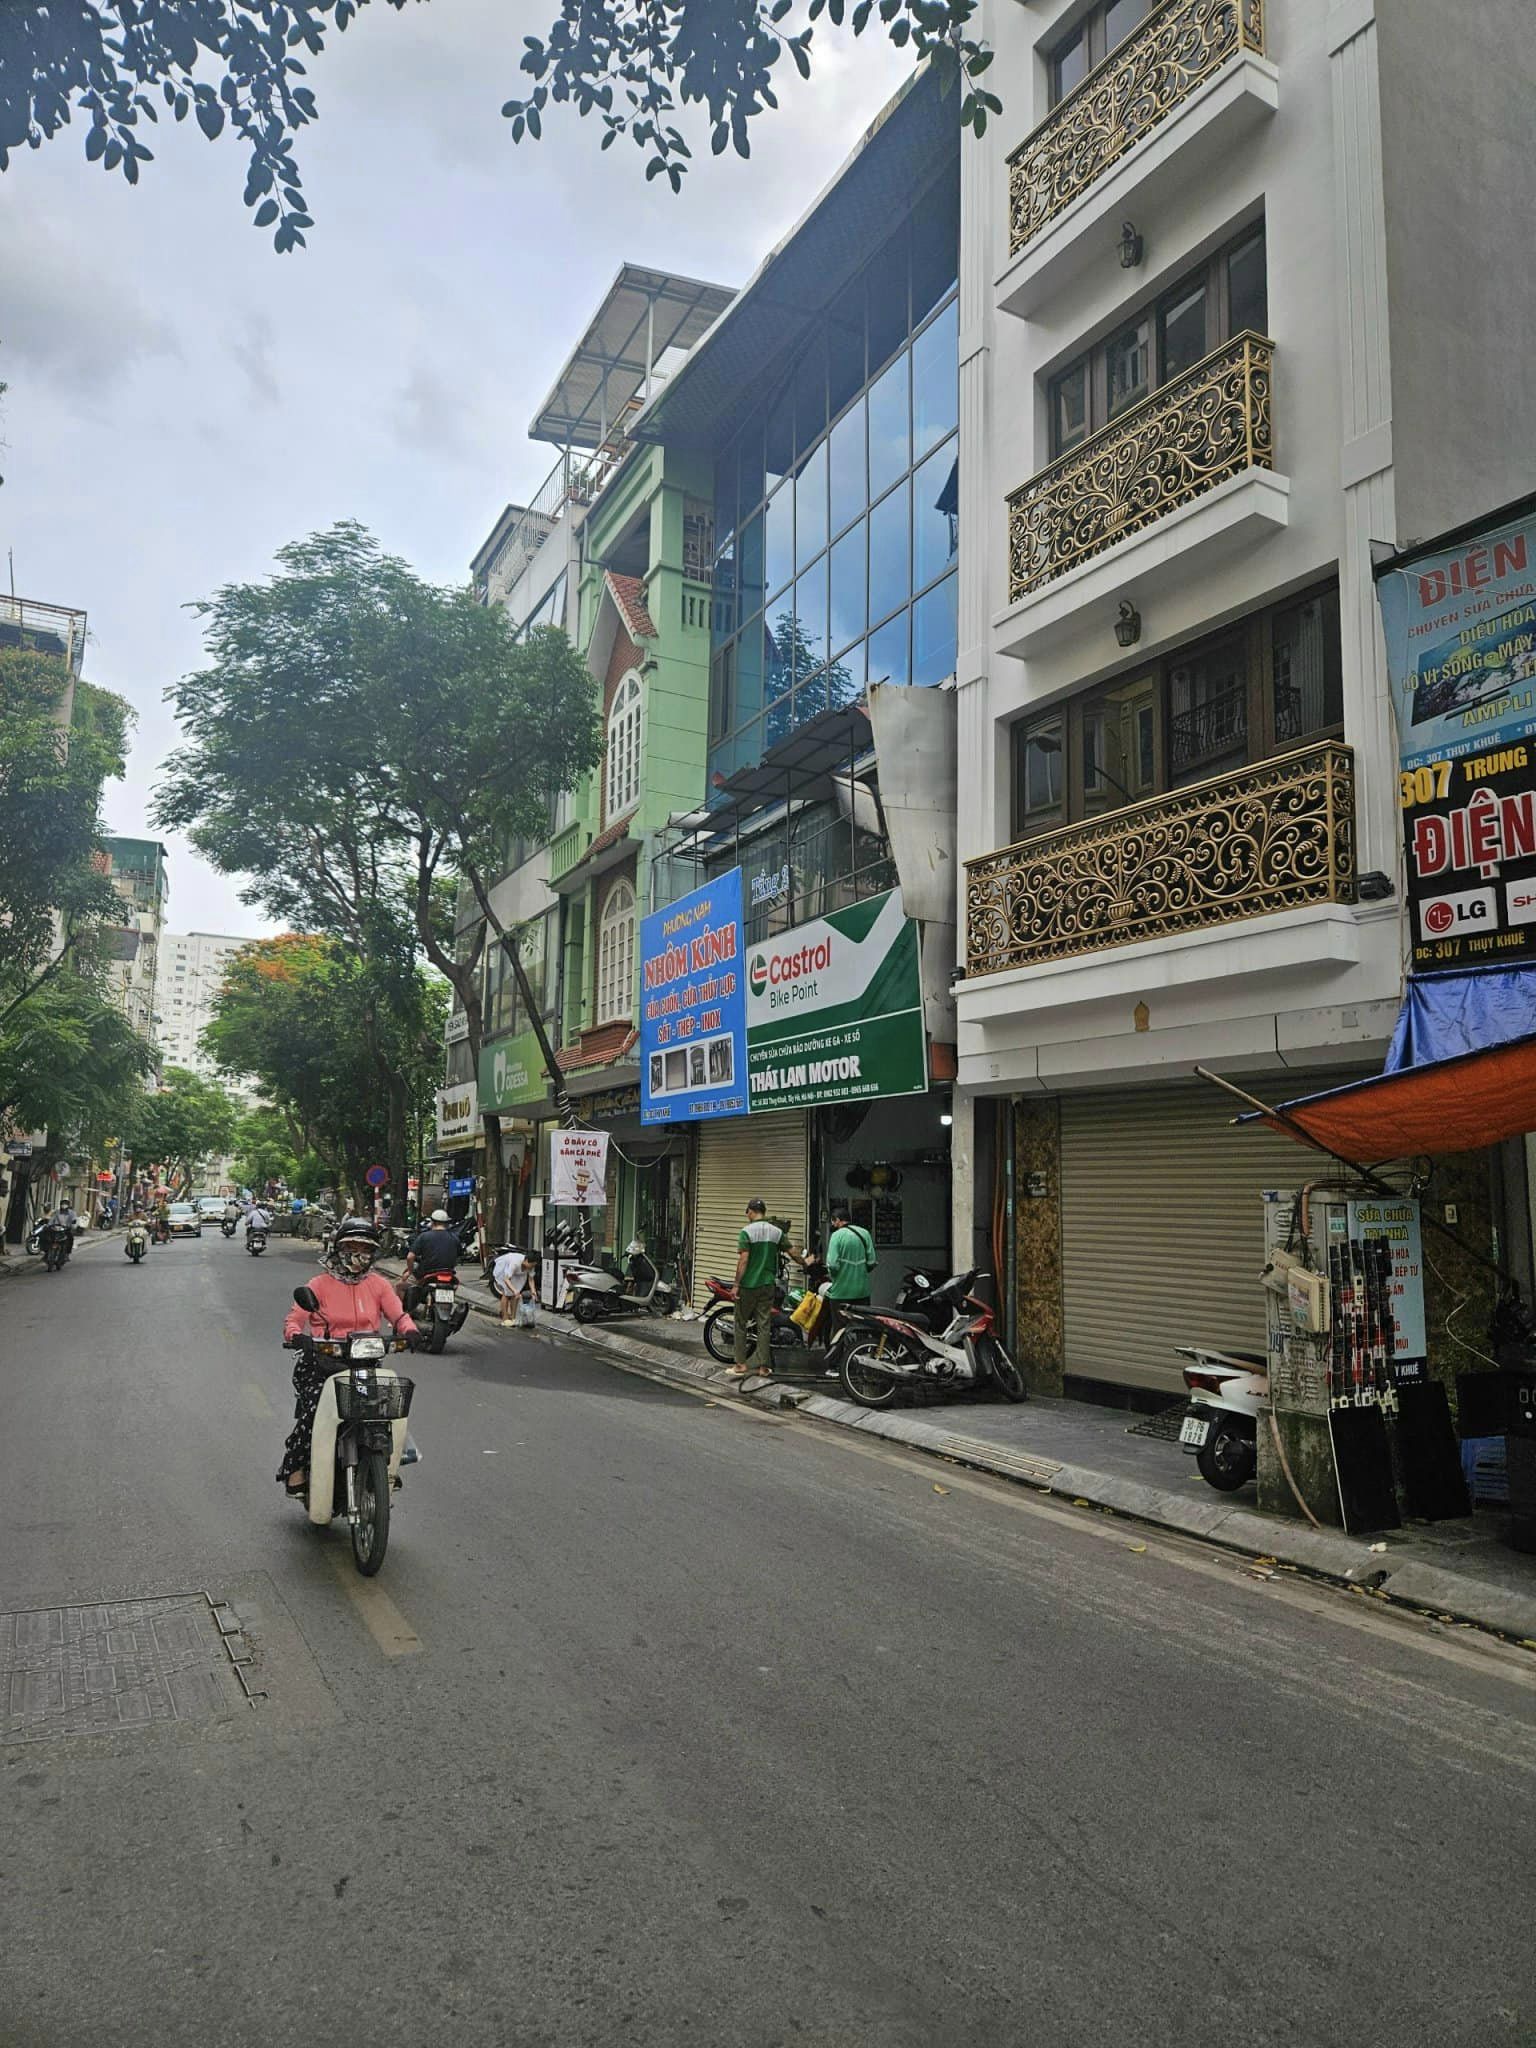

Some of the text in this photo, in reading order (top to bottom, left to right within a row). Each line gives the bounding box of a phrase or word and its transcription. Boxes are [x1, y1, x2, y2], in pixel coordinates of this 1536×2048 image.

[1418, 533, 1528, 609] ĐIỆN
[1461, 690, 1534, 728] AMPLI
[1426, 750, 1443, 764] 307
[1399, 746, 1528, 809] 307 TRUNG
[1412, 788, 1536, 880] ĐIỆN
[1457, 900, 1487, 922] LG
[644, 921, 737, 992] NHÔM KÍNH
[770, 935, 831, 985] Castrol
[1435, 938, 1462, 960] 307
[770, 979, 818, 1009] Bike Point
[701, 1008, 722, 1033] INOX
[844, 1032, 852, 1044] XE
[852, 1029, 861, 1042] SỐ
[750, 1055, 862, 1093] THÁI LAN MOTOR
